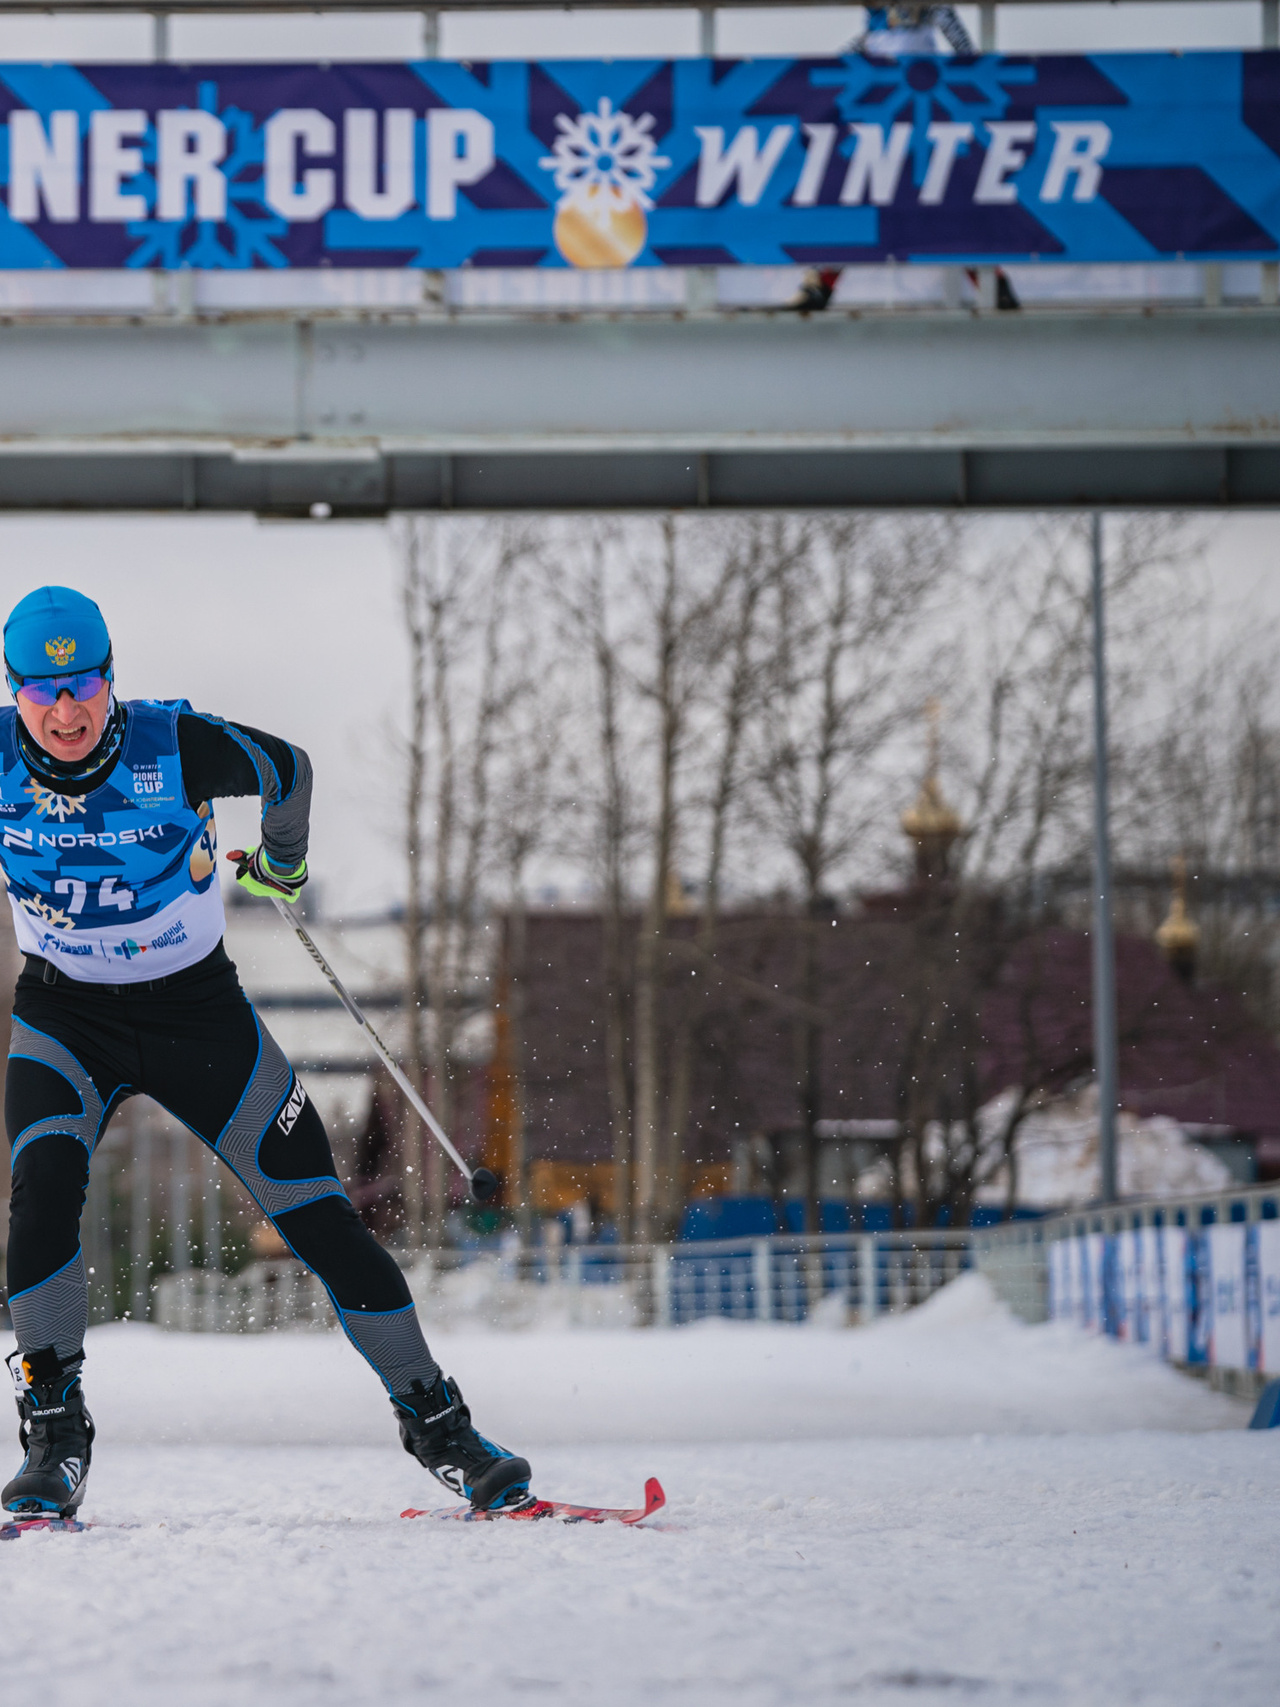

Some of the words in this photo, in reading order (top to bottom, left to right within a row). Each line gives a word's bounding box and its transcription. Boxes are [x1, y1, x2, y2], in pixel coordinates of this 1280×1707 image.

[264, 108, 496, 220] CUP
[694, 121, 1114, 207] WINTER
[133, 772, 163, 781] PIONER
[133, 781, 164, 794] CUP
[38, 824, 165, 848] NORDSKI
[31, 1406, 66, 1416] salomon
[424, 1405, 455, 1424] salomon
